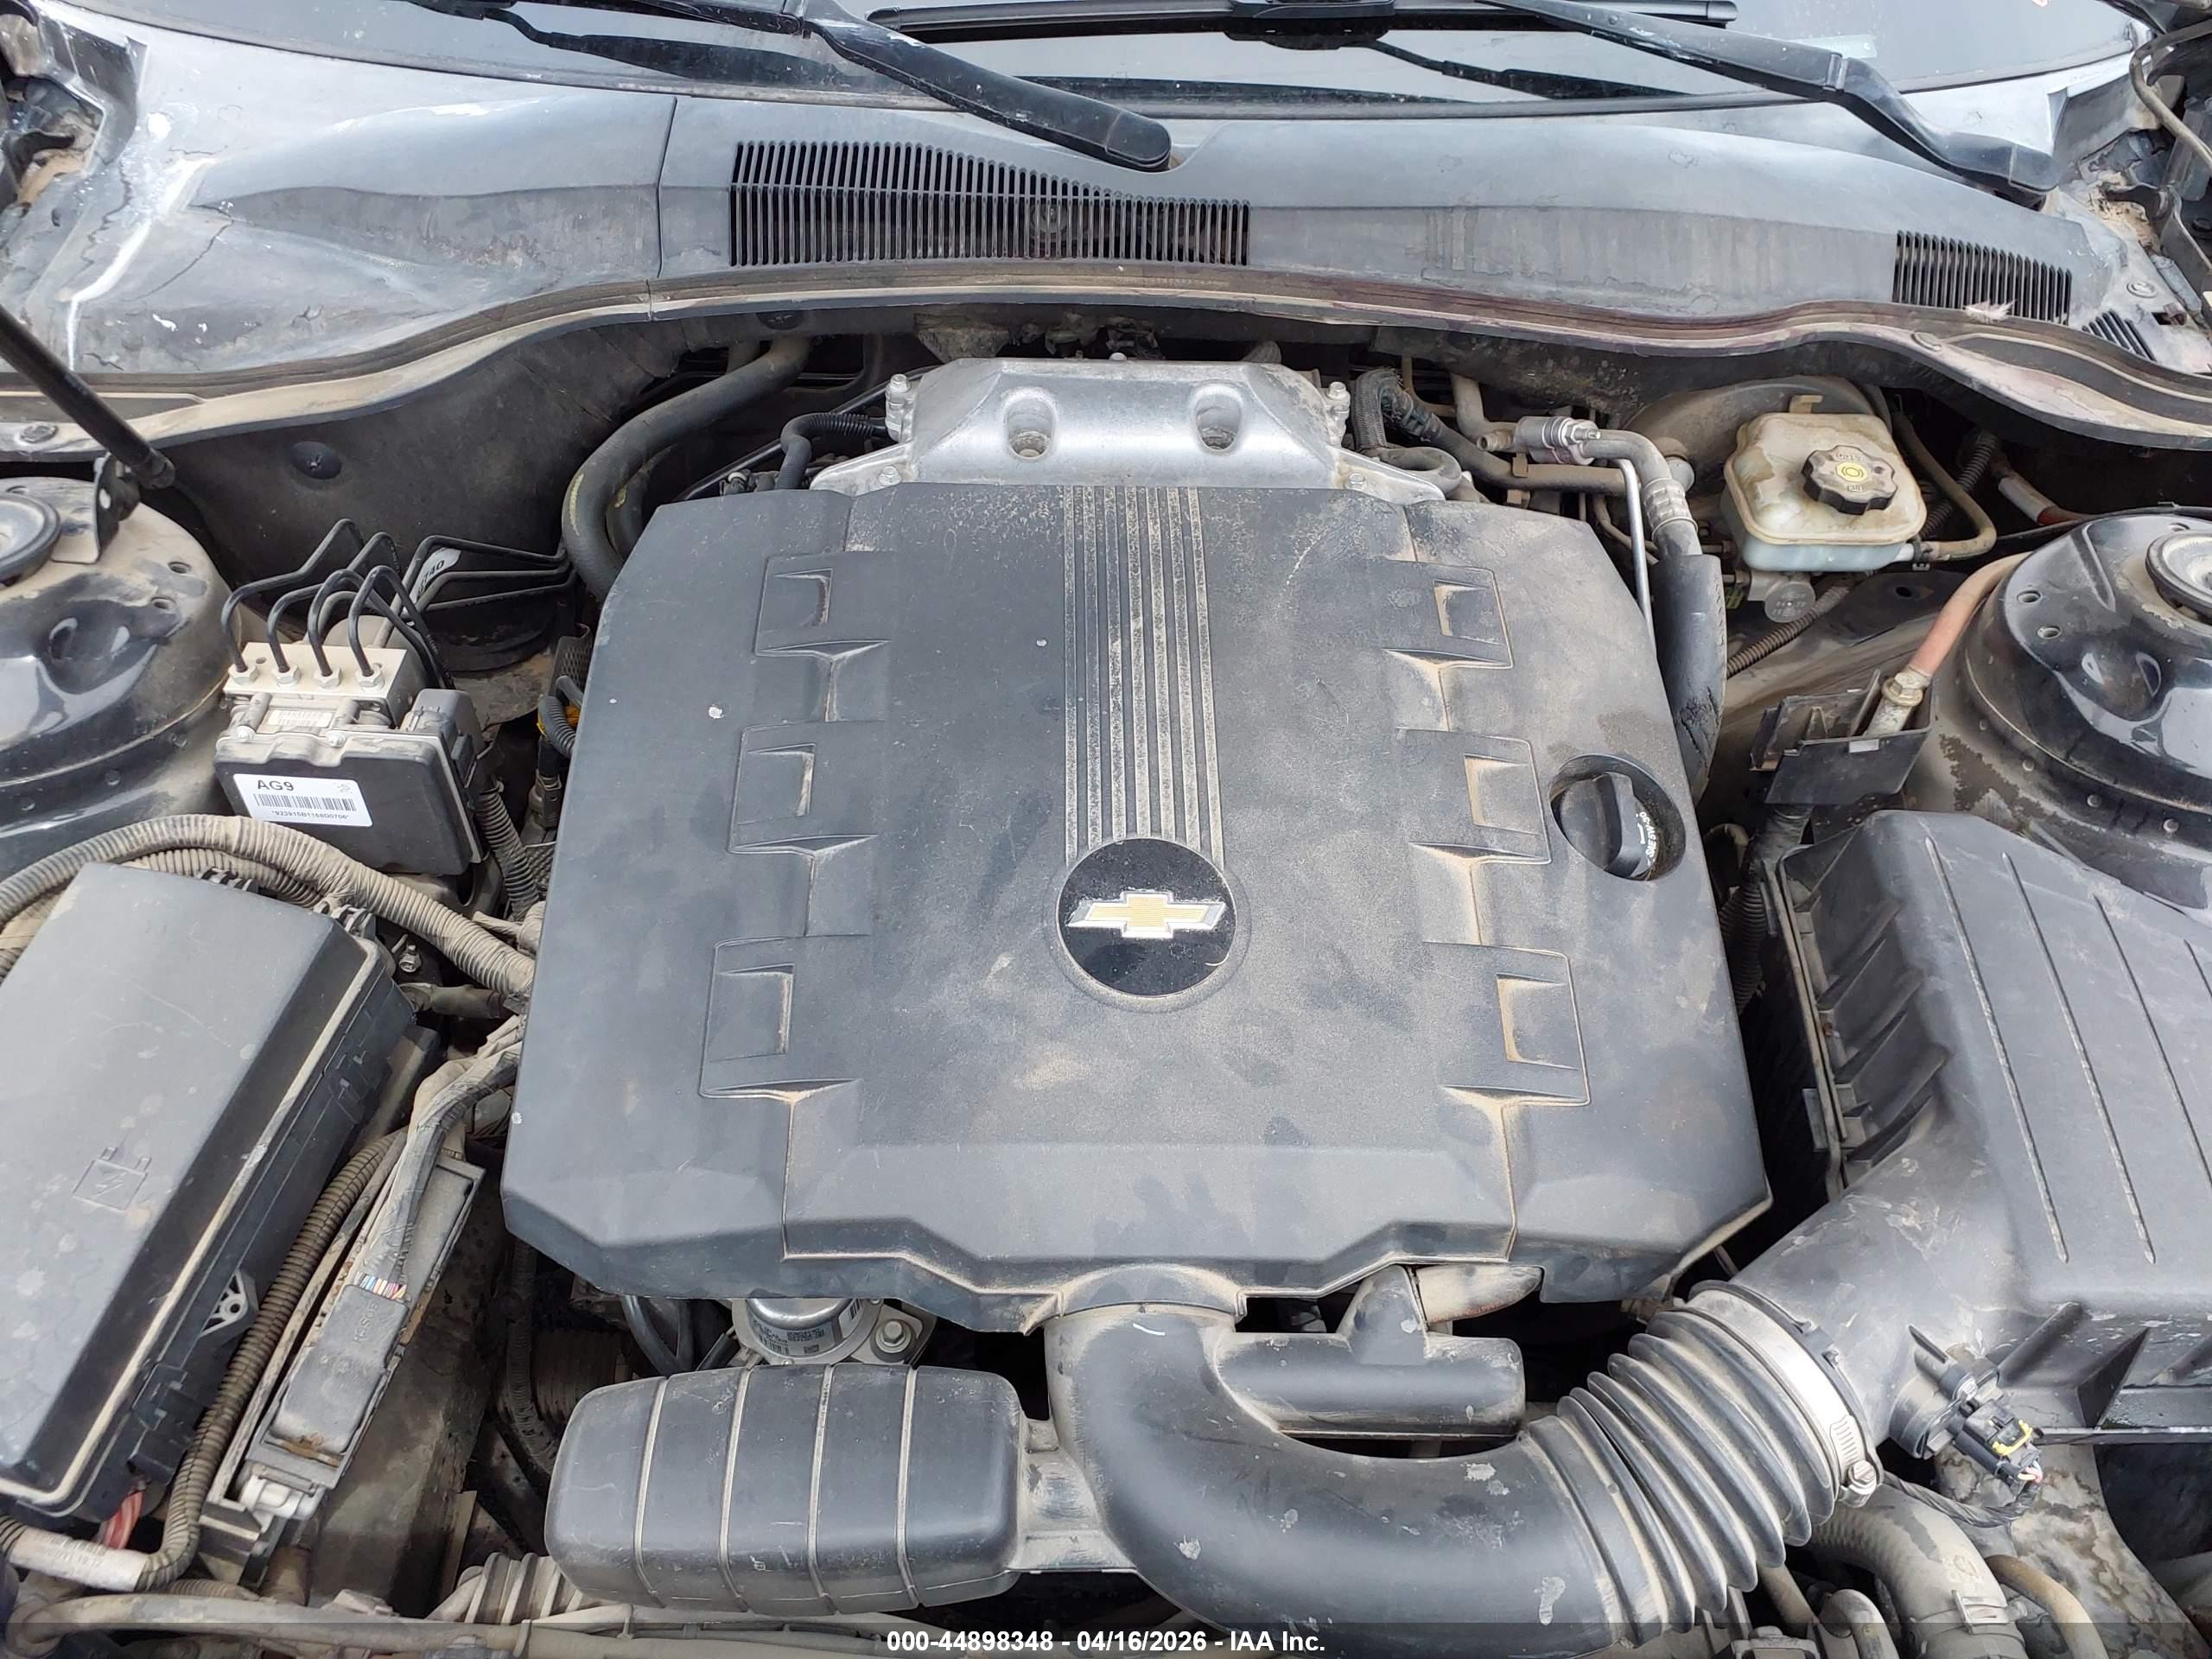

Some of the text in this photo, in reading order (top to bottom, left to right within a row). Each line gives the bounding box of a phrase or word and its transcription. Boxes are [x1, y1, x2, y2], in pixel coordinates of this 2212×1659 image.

[257, 779, 295, 791] AG9
[1639, 811, 1656, 858] SAE 5W-30
